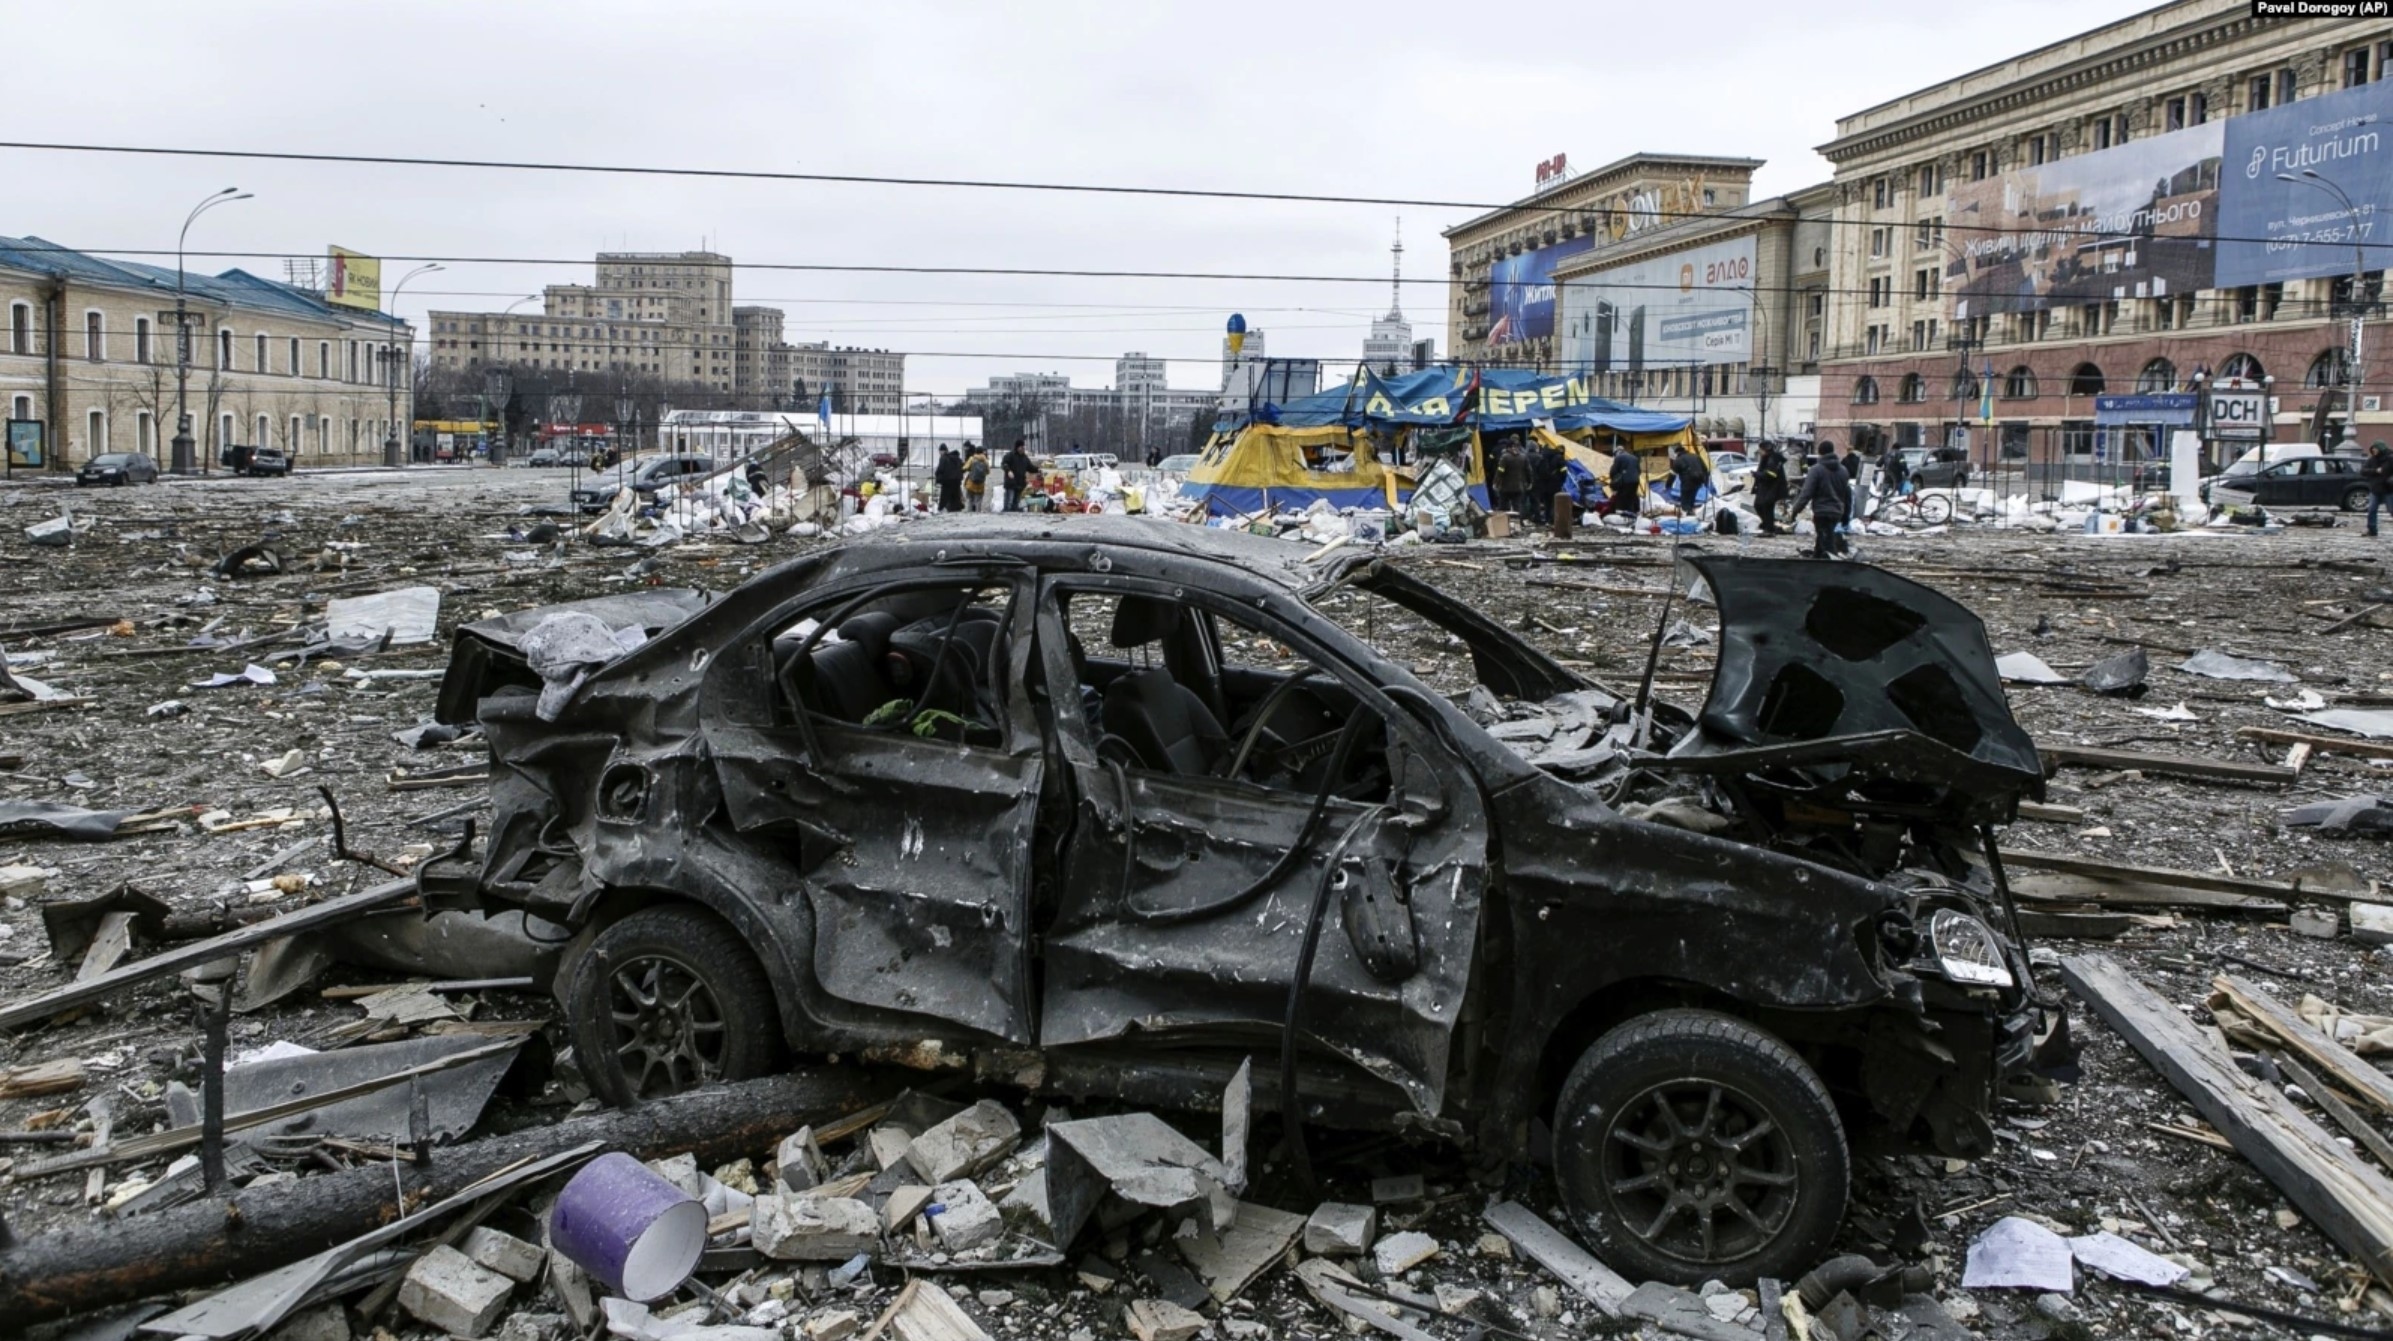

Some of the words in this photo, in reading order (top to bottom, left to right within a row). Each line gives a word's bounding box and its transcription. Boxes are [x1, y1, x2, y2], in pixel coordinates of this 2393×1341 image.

[2309, 120, 2346, 136] Concept
[2272, 131, 2379, 172] Futurium
[2080, 200, 2202, 235] майбутнього
[1365, 390, 1450, 417] ДЯ
[2214, 399, 2258, 421] DCH
